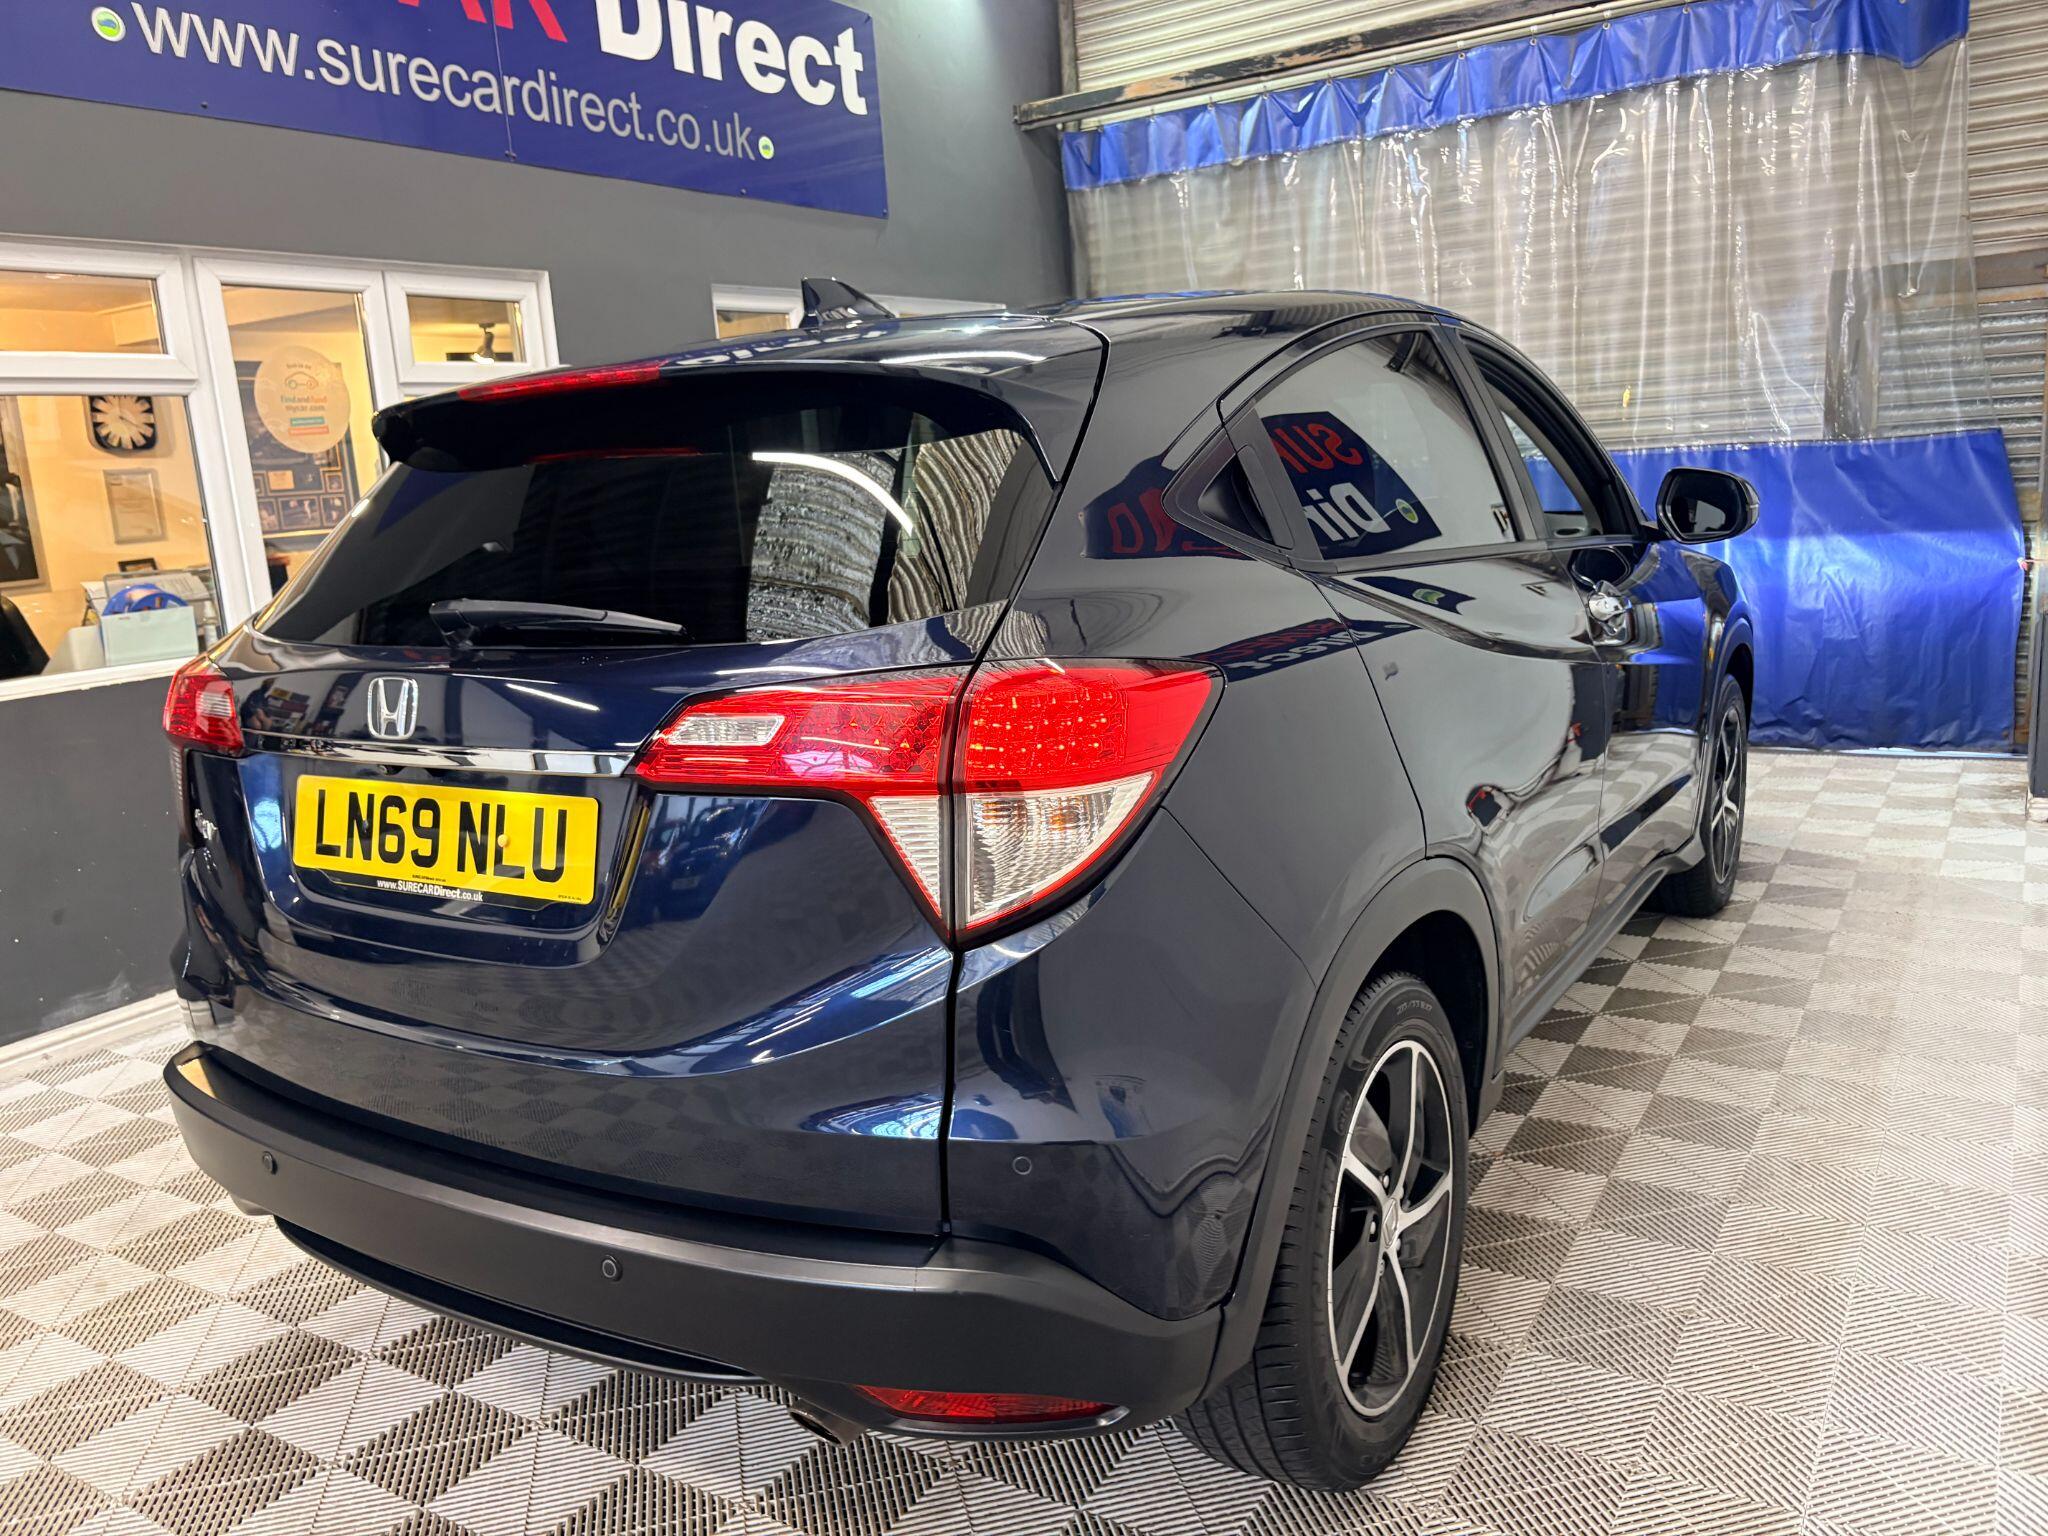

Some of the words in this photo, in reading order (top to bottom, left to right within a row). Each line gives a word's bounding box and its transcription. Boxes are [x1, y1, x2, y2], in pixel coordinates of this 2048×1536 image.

[131, 2, 755, 160] www.surecardirect.co.uk
[315, 789, 441, 868] LN69
[457, 801, 568, 883] NLU
[376, 880, 484, 902] www.SURECARDirect.co.uk
